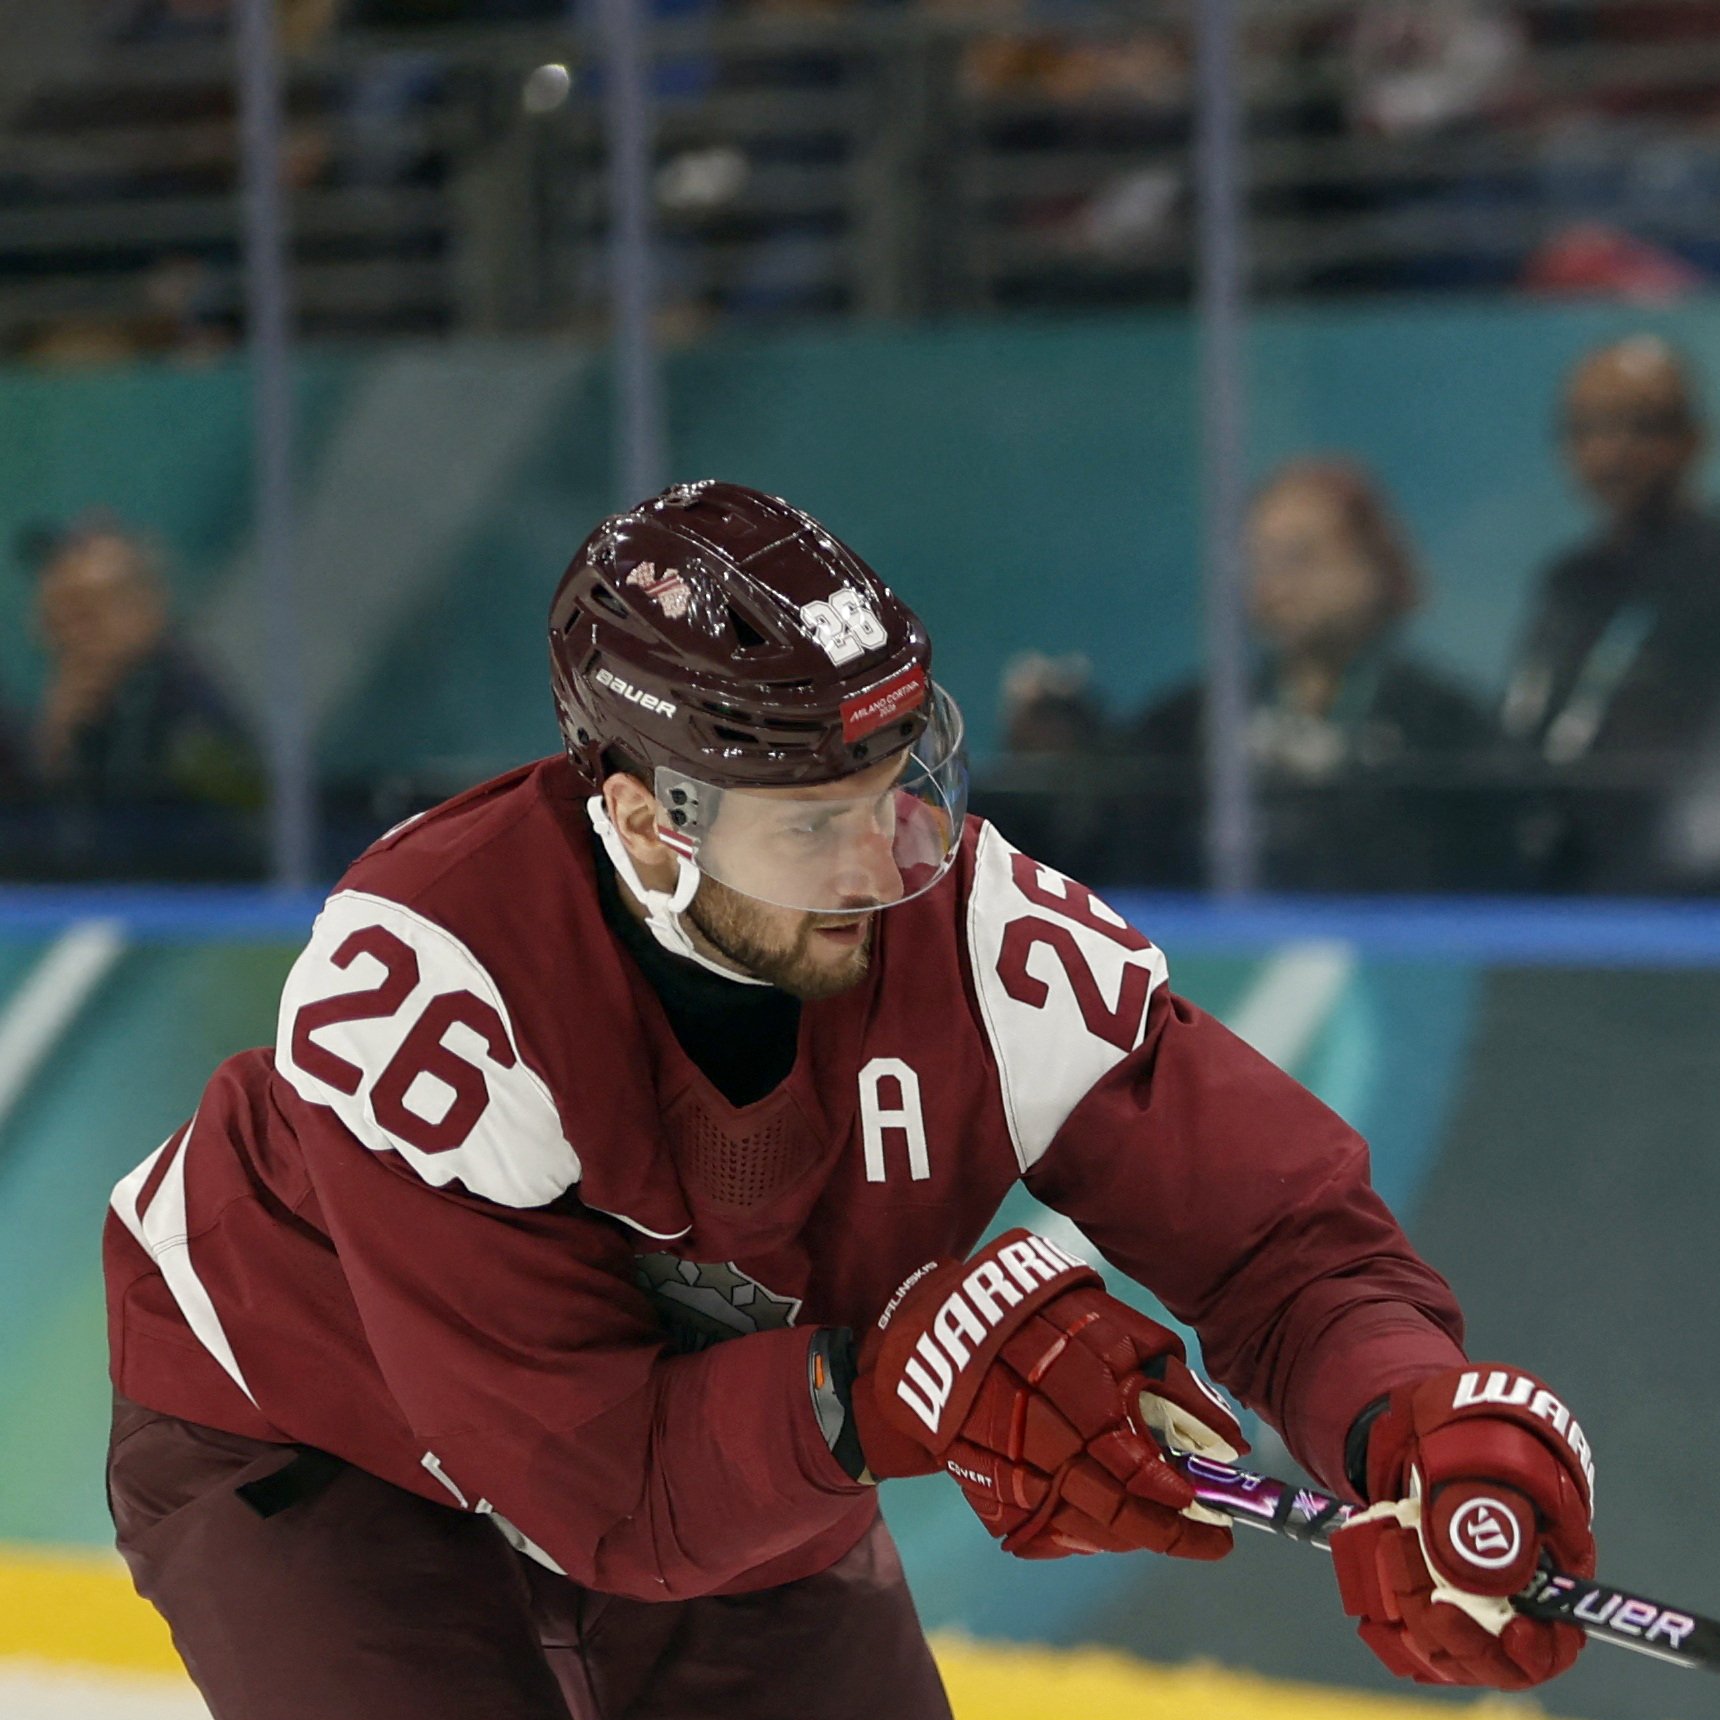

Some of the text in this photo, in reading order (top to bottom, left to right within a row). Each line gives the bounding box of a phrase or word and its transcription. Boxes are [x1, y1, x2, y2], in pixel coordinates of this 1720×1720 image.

[595, 667, 677, 719] BAUER
[800, 588, 888, 668] 26
[996, 852, 1153, 1054] 26
[291, 924, 517, 1155] 26
[857, 1057, 932, 1183] A
[897, 1236, 1090, 1435] WARRI
